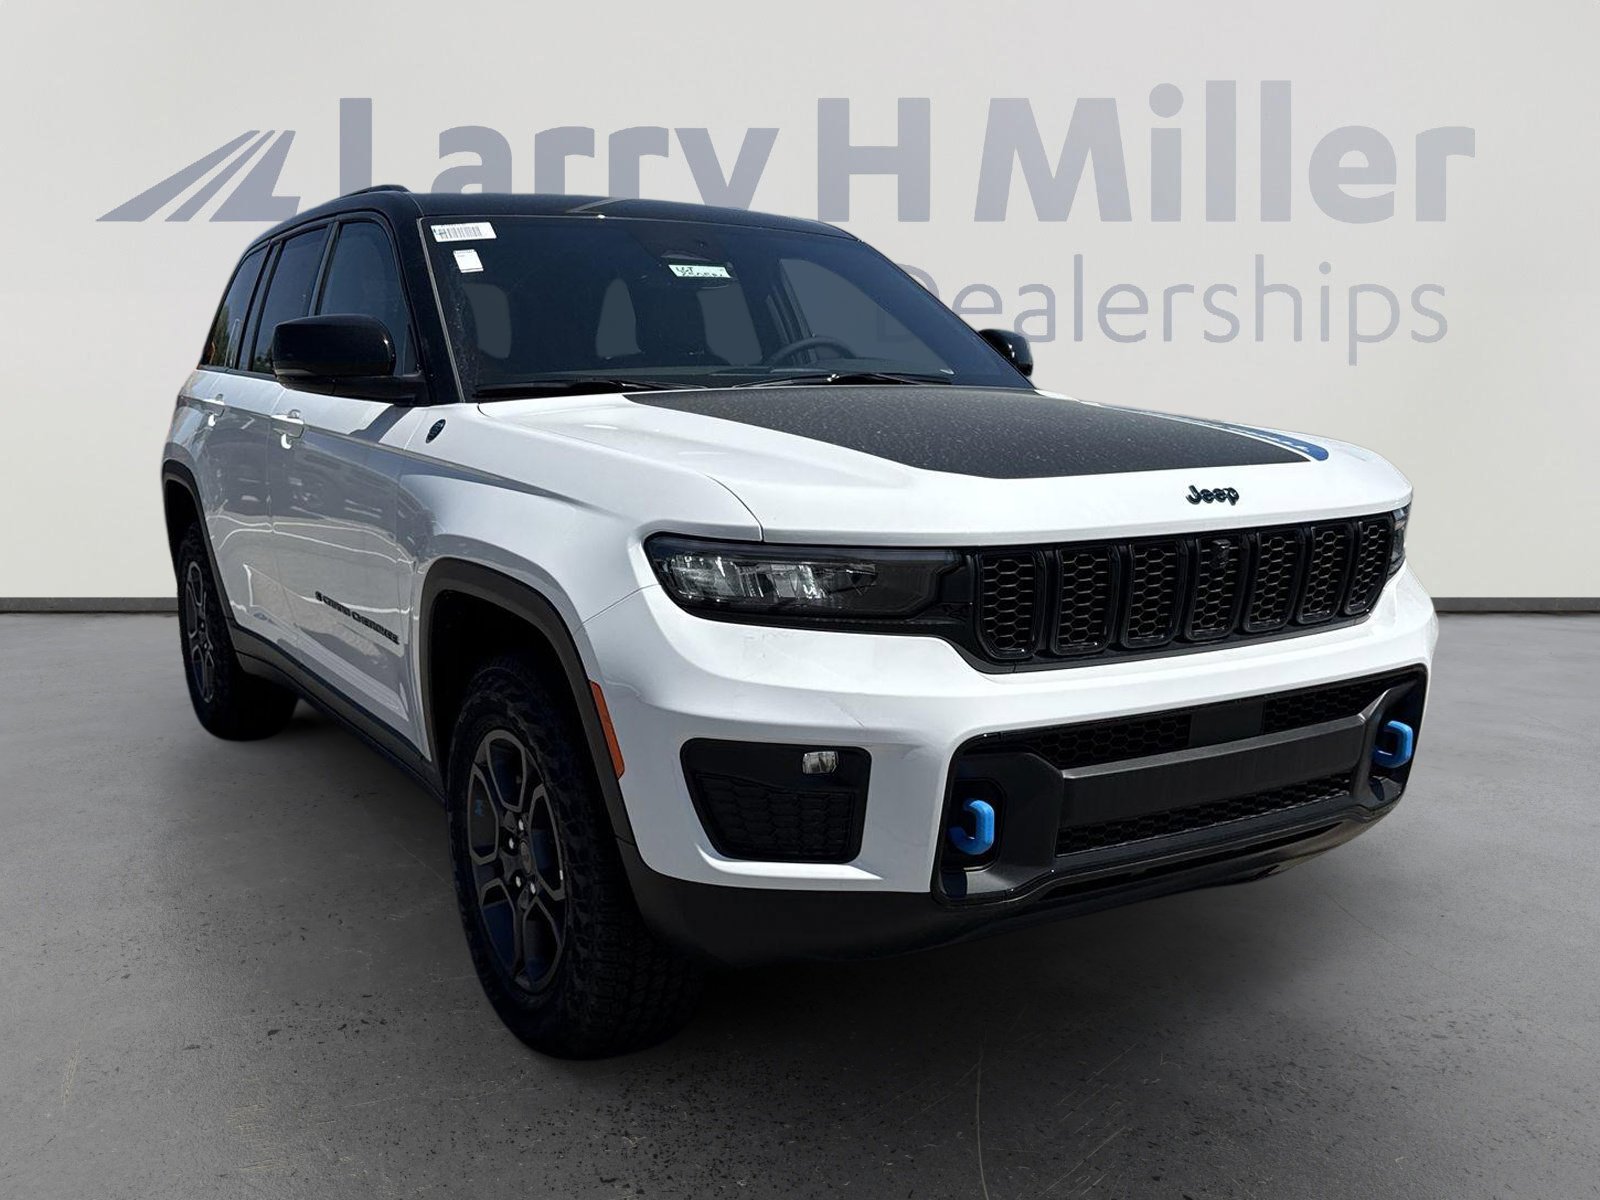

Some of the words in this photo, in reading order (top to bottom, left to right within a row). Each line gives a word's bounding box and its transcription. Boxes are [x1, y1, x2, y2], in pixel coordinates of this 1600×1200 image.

[817, 97, 931, 222] H
[974, 80, 1476, 224] Miller
[1186, 484, 1239, 506] Jeep
